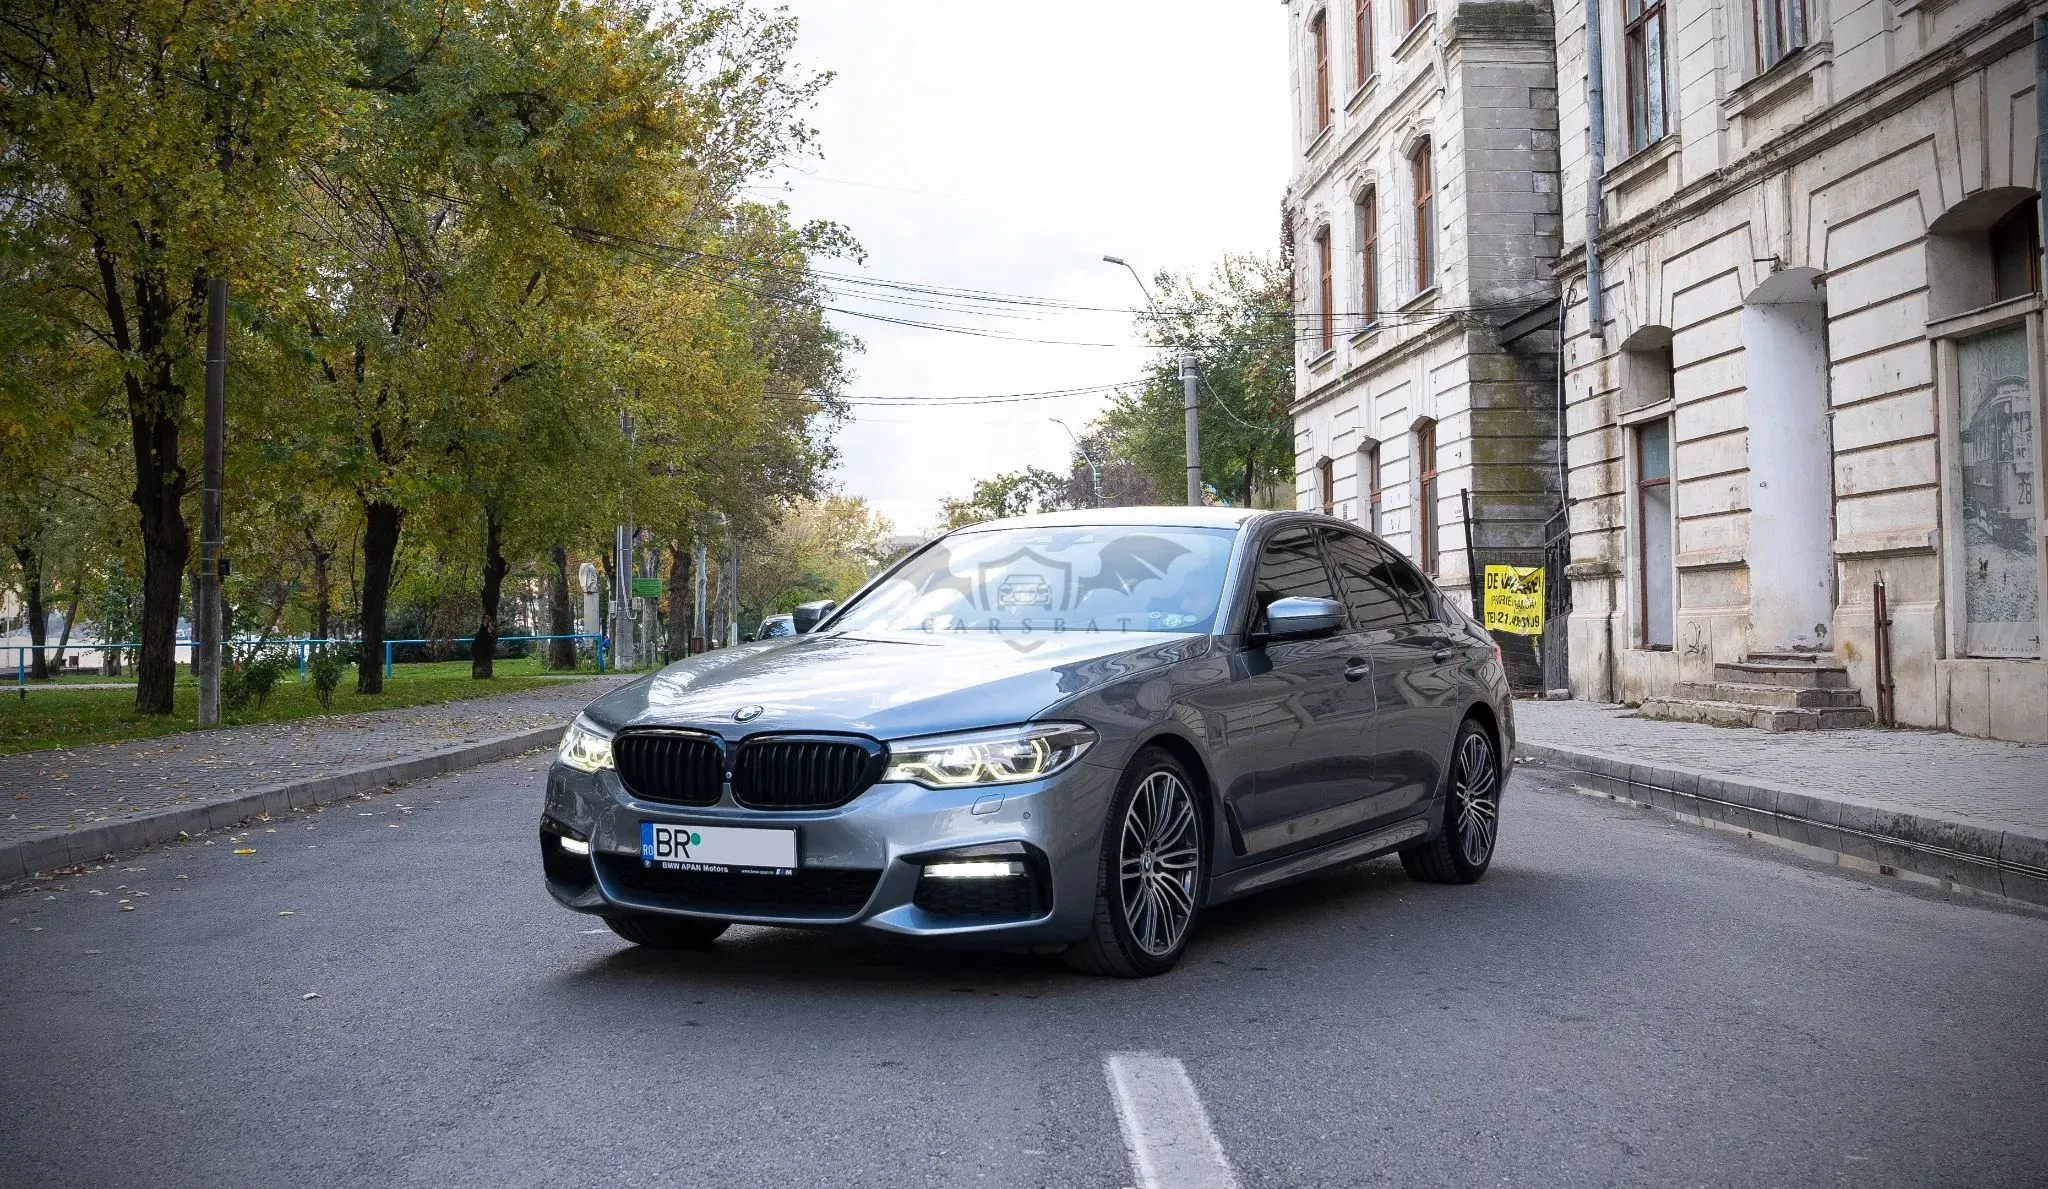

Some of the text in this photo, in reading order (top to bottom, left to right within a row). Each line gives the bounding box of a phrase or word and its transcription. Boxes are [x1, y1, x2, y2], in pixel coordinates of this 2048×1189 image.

[2017, 482, 2032, 505] 28
[1487, 573, 1498, 589] DE
[643, 844, 653, 856] RO
[655, 828, 690, 858] BR
[662, 861, 729, 873] BMW APAN Motors
